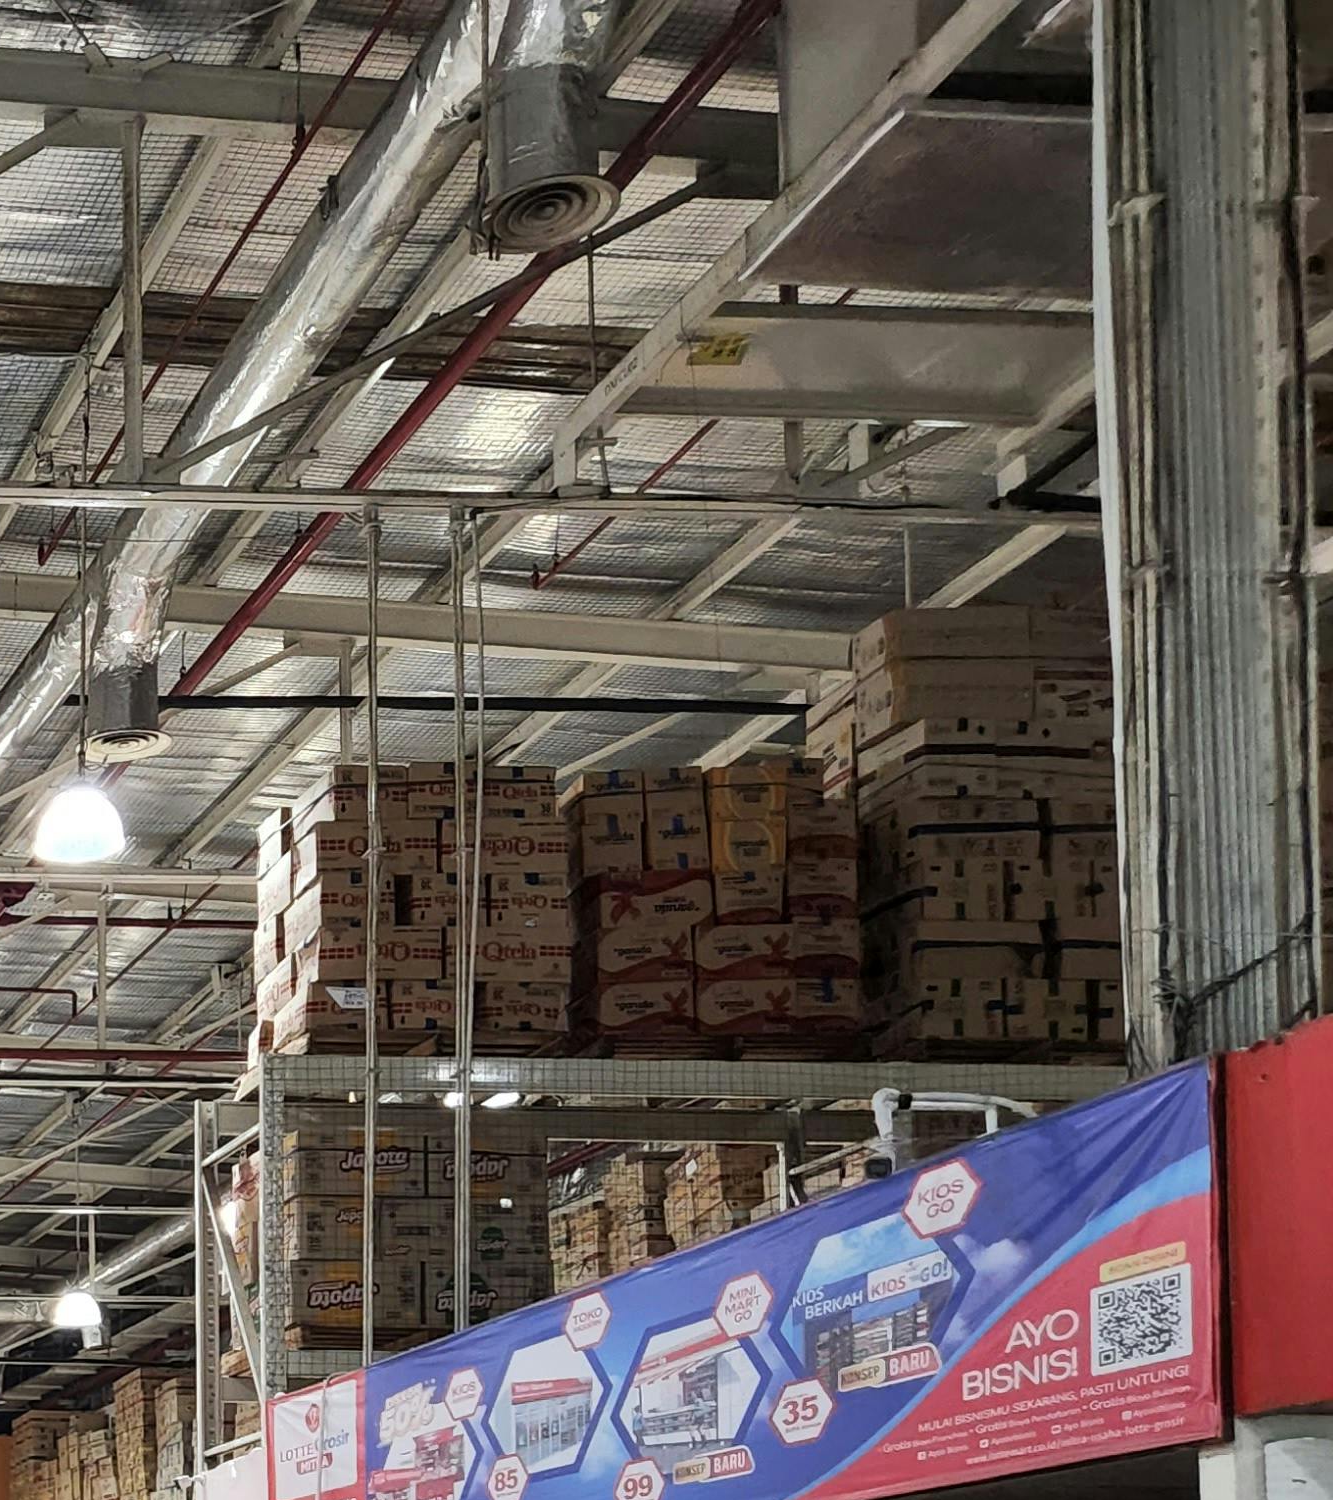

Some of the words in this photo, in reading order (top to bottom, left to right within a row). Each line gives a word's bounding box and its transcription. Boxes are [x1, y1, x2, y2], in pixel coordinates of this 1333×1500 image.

[917, 1178, 965, 1206] KIOS
[926, 1198, 954, 1218] GO
[729, 1286, 757, 1302] MINI
[792, 1287, 825, 1307] KIOS
[870, 1276, 906, 1297] KIOS
[724, 1295, 762, 1316] MART
[805, 1290, 864, 1319] BERKAH
[572, 1307, 603, 1325] TOKO
[734, 1310, 752, 1323] GO
[1005, 1309, 1079, 1353] AYO
[889, 1352, 931, 1377] BARU
[962, 1347, 1078, 1401] BISNIS!
[453, 1381, 477, 1396] KIOS
[782, 1395, 819, 1426] 35
[918, 1418, 952, 1432] MULAI
[955, 1405, 1010, 1425] BISNISMU
[1080, 1383, 1114, 1398] PASTI
[280, 1444, 313, 1463] LOTTE
[713, 1451, 746, 1473] BARU
[300, 1456, 329, 1475] MITA
[494, 1468, 518, 1492] 85
[623, 1474, 654, 1500] 99
